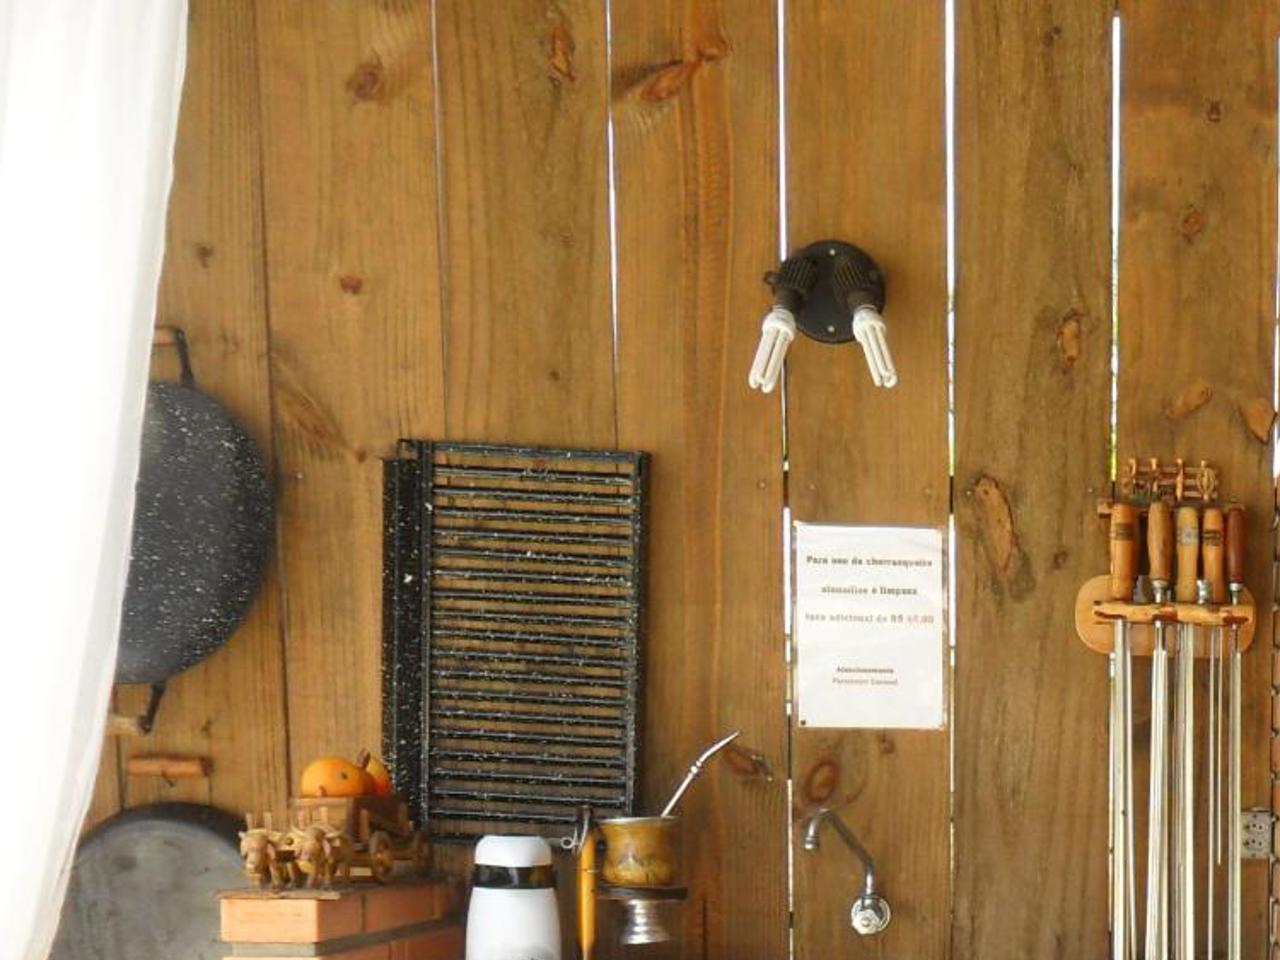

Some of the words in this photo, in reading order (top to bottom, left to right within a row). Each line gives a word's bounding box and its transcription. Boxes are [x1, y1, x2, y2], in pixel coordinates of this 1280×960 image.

[806, 555, 828, 565] Para
[831, 557, 848, 565] uso
[871, 587, 877, 595] e
[880, 585, 918, 597] limpeza
